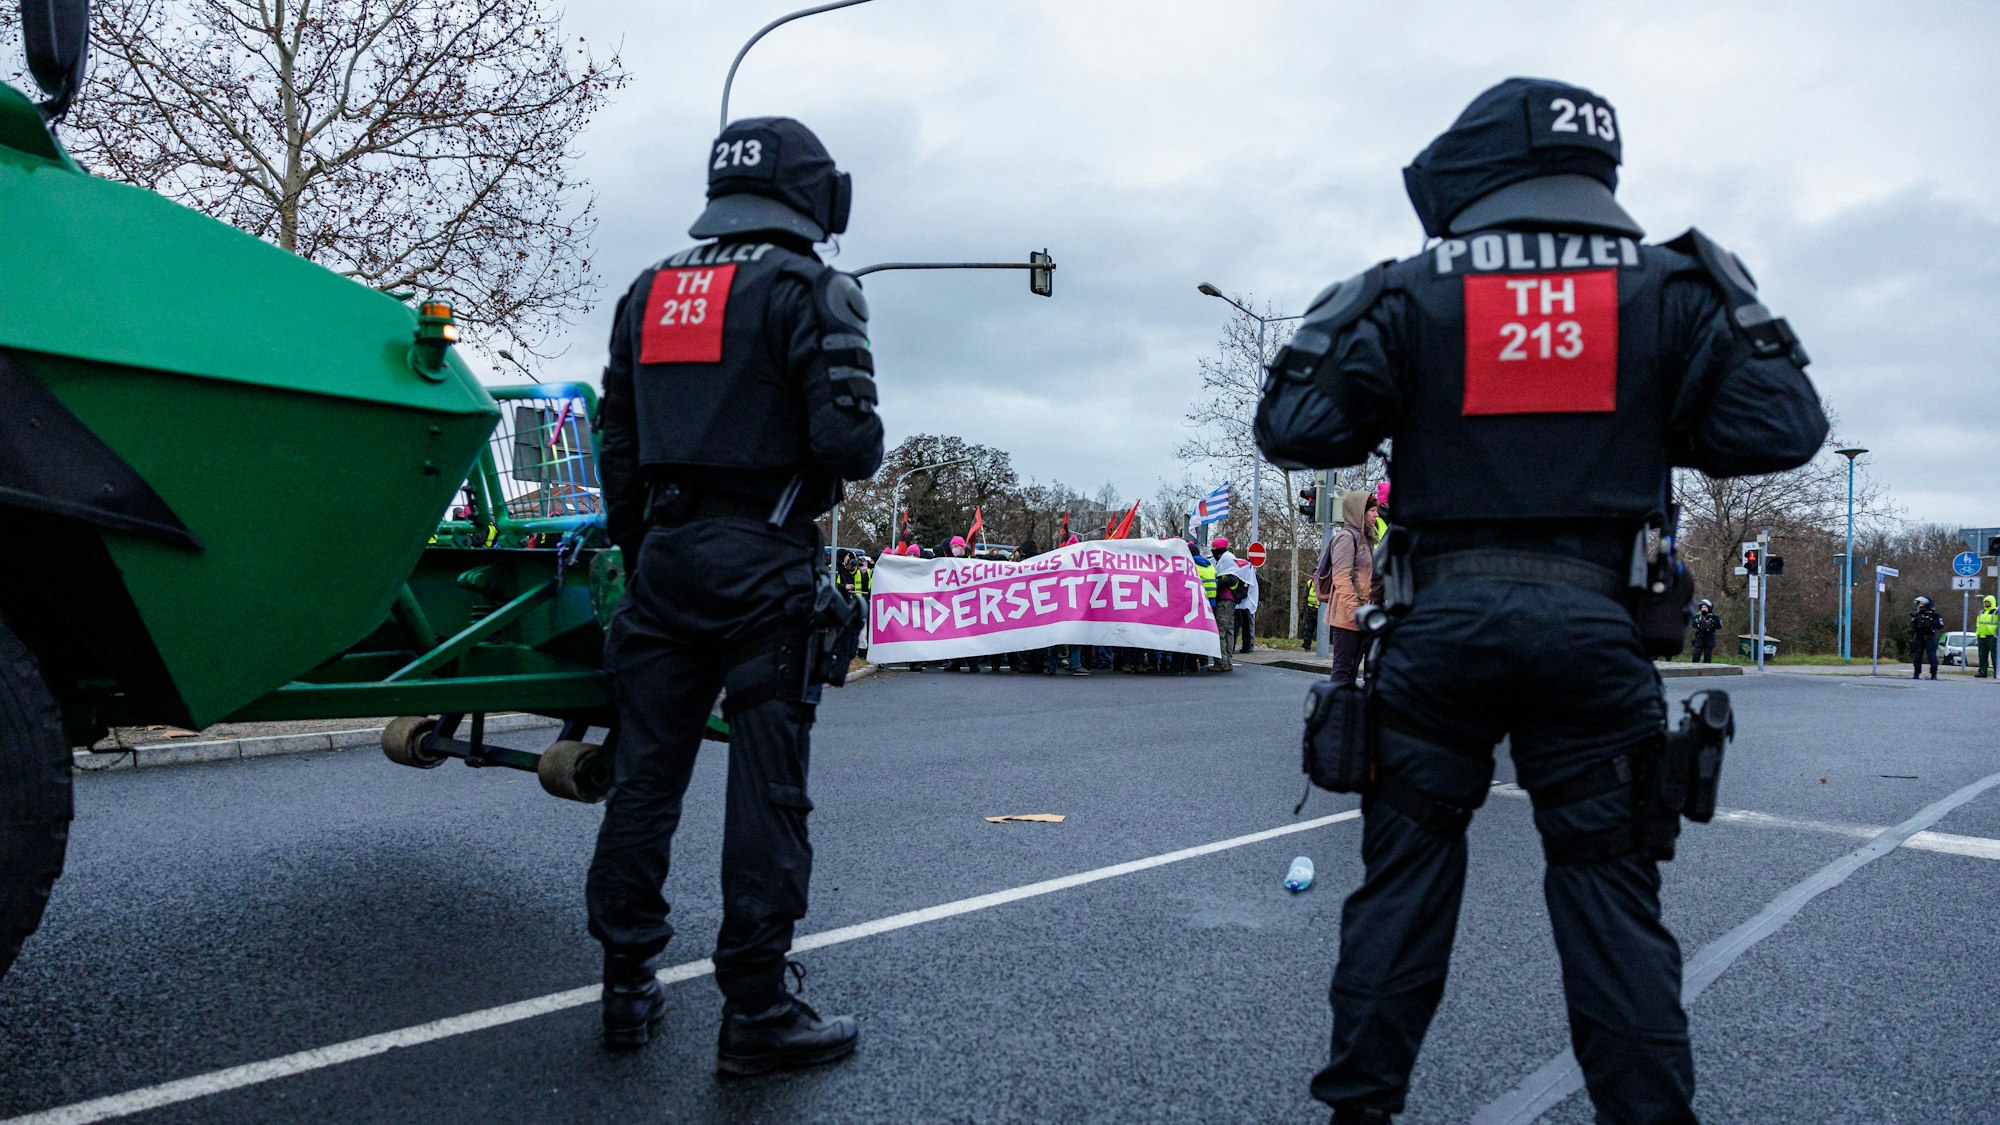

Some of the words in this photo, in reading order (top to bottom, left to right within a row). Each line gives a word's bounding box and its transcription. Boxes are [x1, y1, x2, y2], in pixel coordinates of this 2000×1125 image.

[1550, 98, 1615, 142] 213
[713, 139, 762, 170] 213
[653, 242, 775, 271] OLIZEI
[1436, 233, 1639, 274] POLIZEI
[676, 271, 714, 295] TH
[1506, 278, 1576, 316] TH
[659, 298, 708, 326] 213
[1498, 320, 1584, 361] 213
[934, 554, 1062, 587] FASCHISMUS
[1071, 550, 1199, 577] VERHINDER
[877, 573, 1169, 634] WIDERSETZEN
